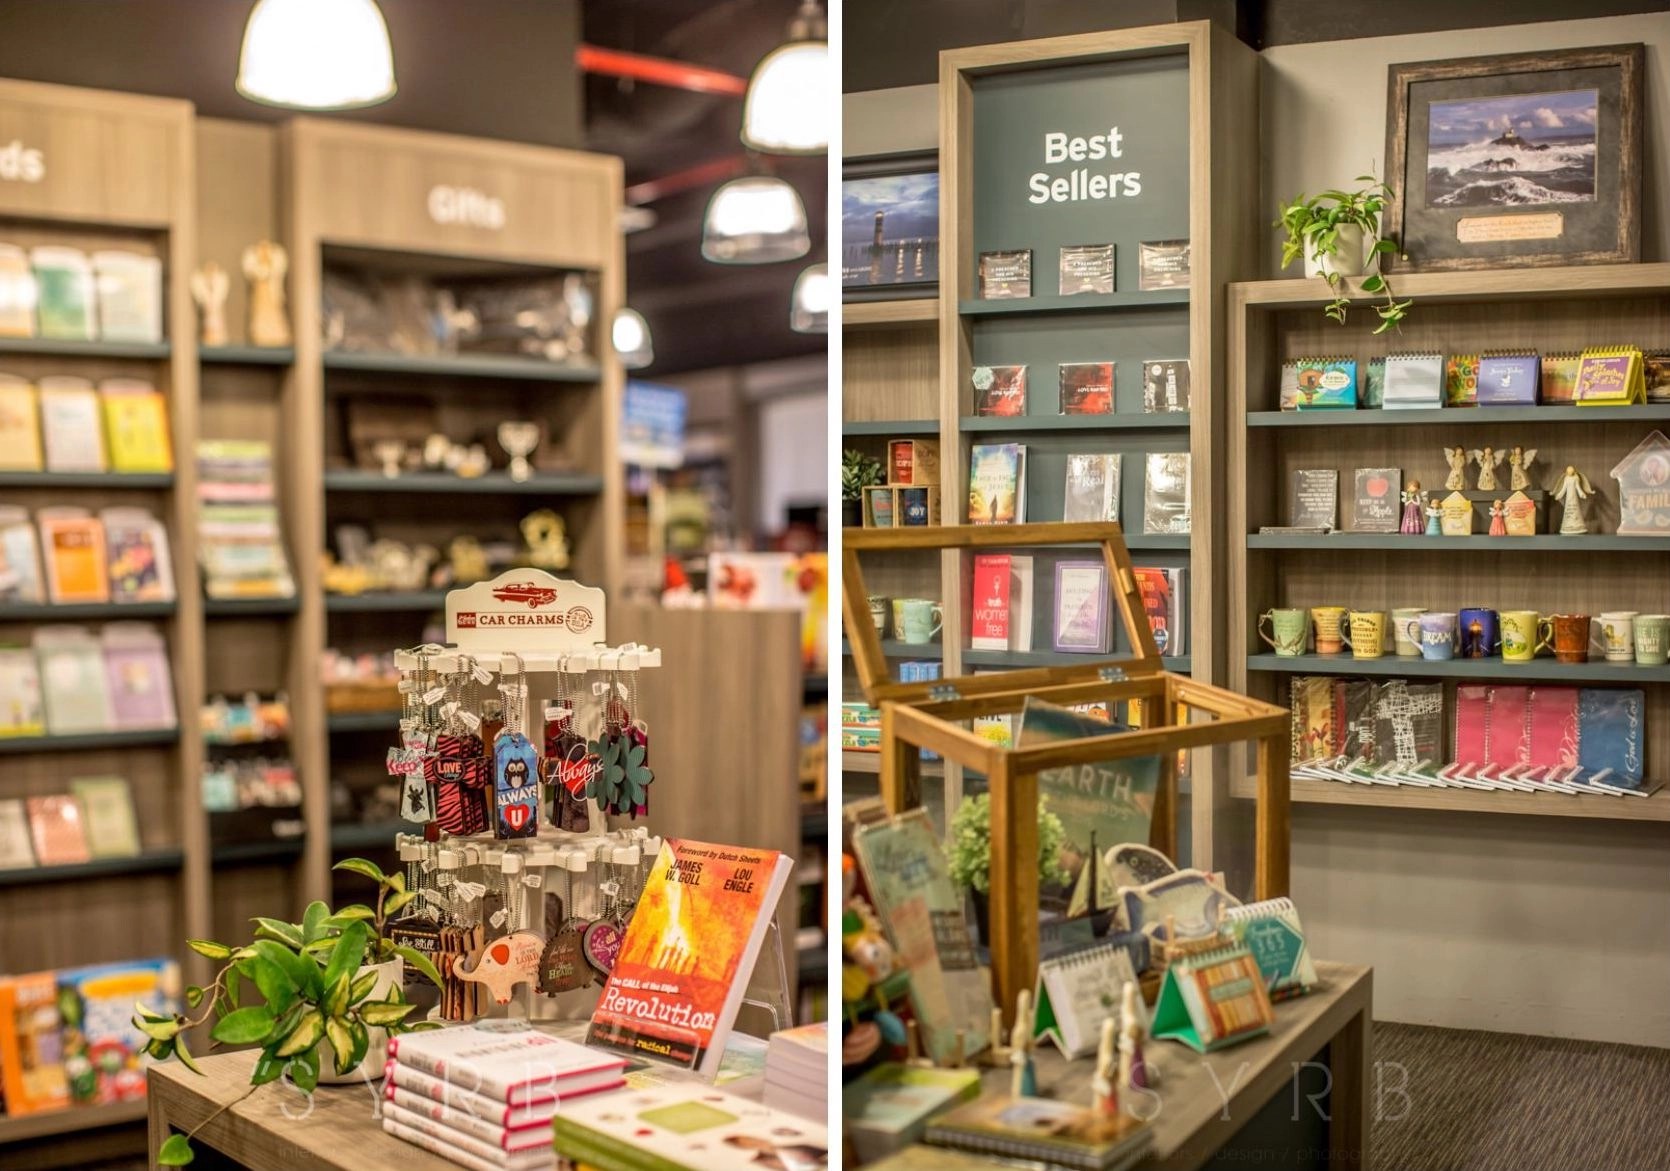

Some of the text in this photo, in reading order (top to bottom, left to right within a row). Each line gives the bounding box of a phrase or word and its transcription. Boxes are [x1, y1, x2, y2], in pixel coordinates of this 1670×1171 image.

[1045, 126, 1123, 164] Best
[1028, 168, 1142, 204] Sellers
[428, 185, 506, 229] Gifts
[910, 507, 925, 516] JOY
[480, 615, 505, 625] CAR
[508, 615, 564, 625] CHARMS
[986, 621, 1004, 637] free
[1423, 631, 1451, 645] DREAM
[437, 760, 462, 774] LOVE
[547, 744, 604, 801] Always
[511, 809, 523, 825] U
[678, 845, 762, 865] Foreword by Dutch Sheets
[670, 859, 703, 873] JAMES
[665, 869, 700, 885] W. GOLL
[734, 868, 753, 881] LOU
[723, 879, 754, 893] ENGLE
[622, 978, 640, 989] CALL
[600, 987, 716, 1030] Revolution
[636, 1040, 671, 1055] radical
